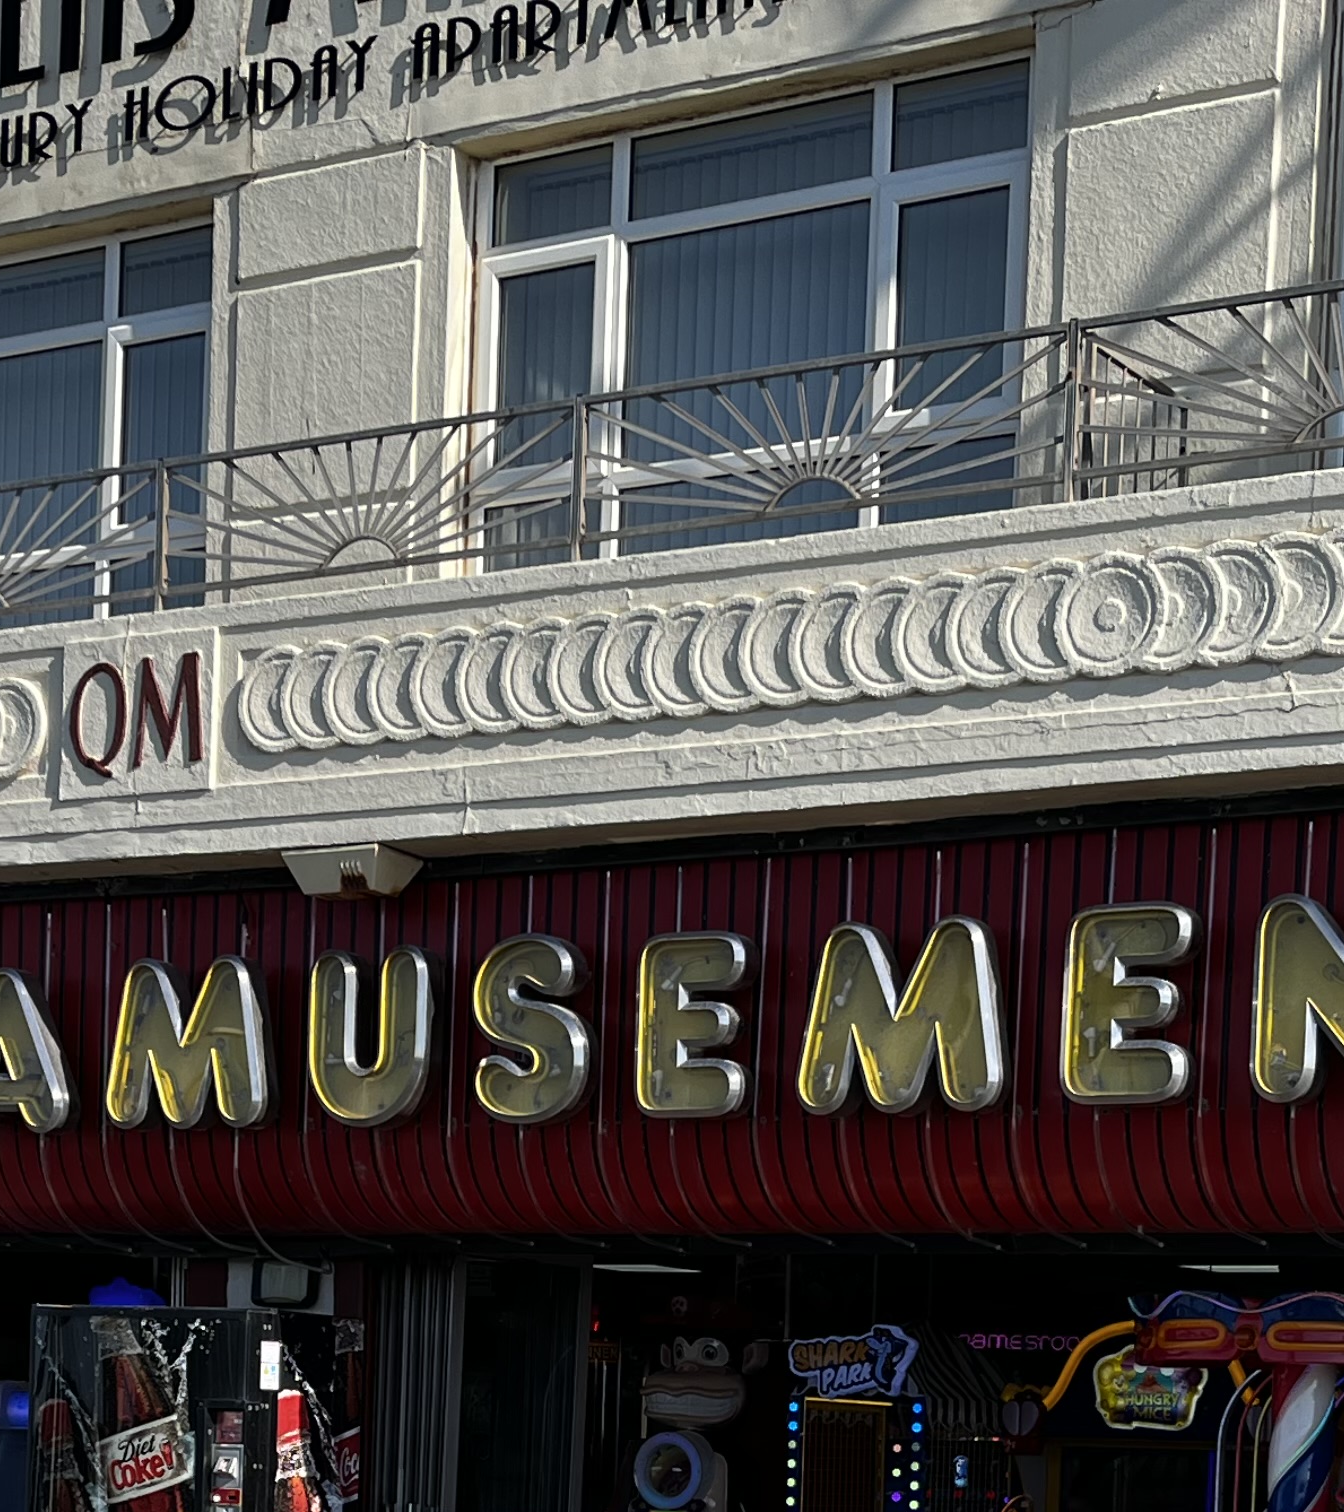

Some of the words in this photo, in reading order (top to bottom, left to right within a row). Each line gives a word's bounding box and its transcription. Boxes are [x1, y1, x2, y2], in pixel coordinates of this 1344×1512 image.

[124, 34, 379, 142] HOLIDAY
[410, 0, 786, 80] APARTM
[69, 651, 204, 778] QM
[793, 1339, 870, 1371] SHARK
[821, 1362, 873, 1393] PARK
[1128, 1393, 1180, 1407] HUNGRY
[1133, 1406, 1172, 1420] MICE
[117, 1434, 156, 1462] Diet
[110, 1454, 165, 1491] Coke
